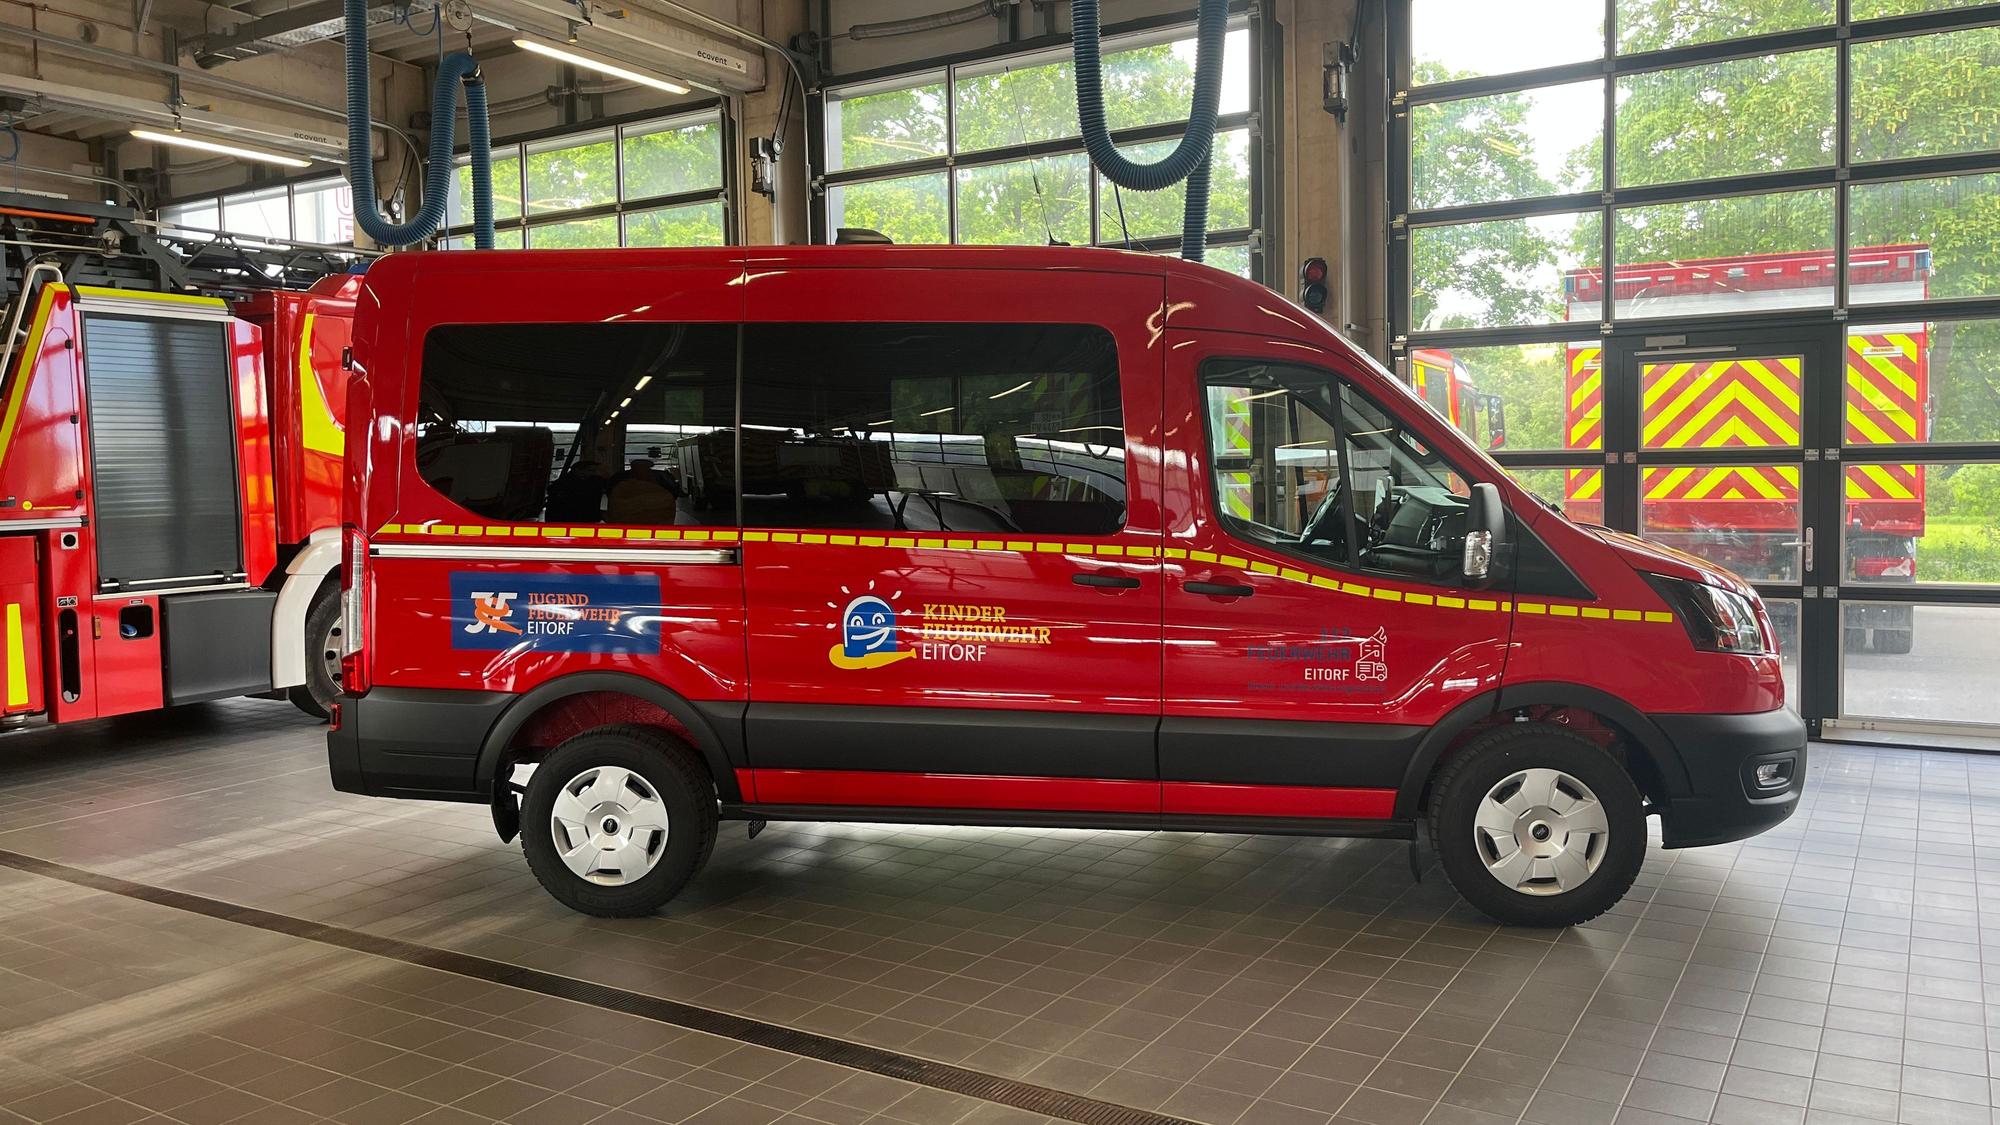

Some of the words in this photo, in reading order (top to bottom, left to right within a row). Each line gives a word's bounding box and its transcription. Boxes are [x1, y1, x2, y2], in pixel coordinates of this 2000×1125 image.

[697, 50, 727, 65] ecovent
[294, 132, 327, 143] ecovent
[528, 592, 589, 606] JUGEND
[527, 607, 621, 622] FEUEWEHR
[923, 604, 1006, 622] KINDER
[527, 621, 574, 635] EITORF
[922, 623, 1051, 644] FEUERWEHR
[922, 643, 987, 661] EITORF
[1247, 645, 1351, 662] FEUERWEHR
[1304, 668, 1350, 680] EITORF
